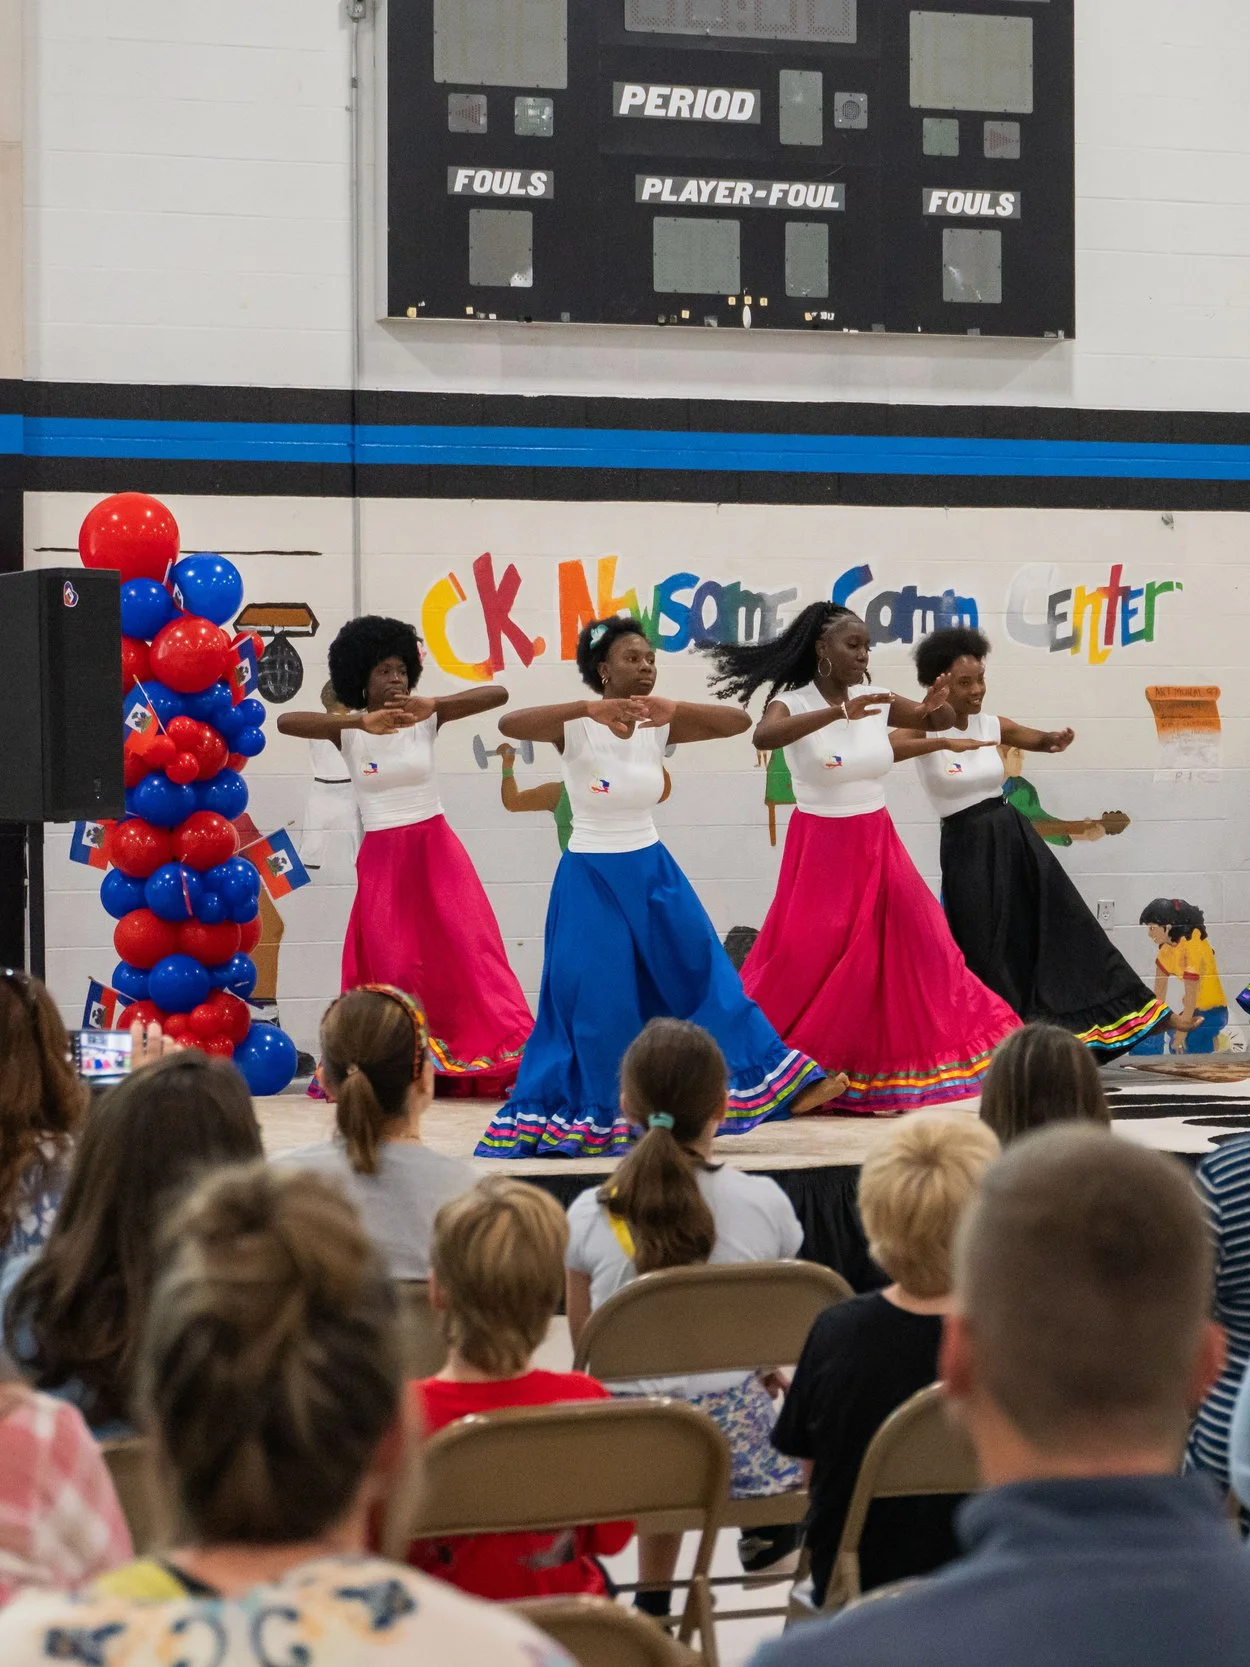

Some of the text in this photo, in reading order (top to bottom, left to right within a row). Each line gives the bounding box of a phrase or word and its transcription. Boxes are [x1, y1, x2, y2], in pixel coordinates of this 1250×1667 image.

[618, 84, 756, 122] PERIOD
[453, 168, 548, 196] FOULS
[641, 177, 840, 209] PLAYER-FOUL
[928, 190, 1015, 217] FOULS
